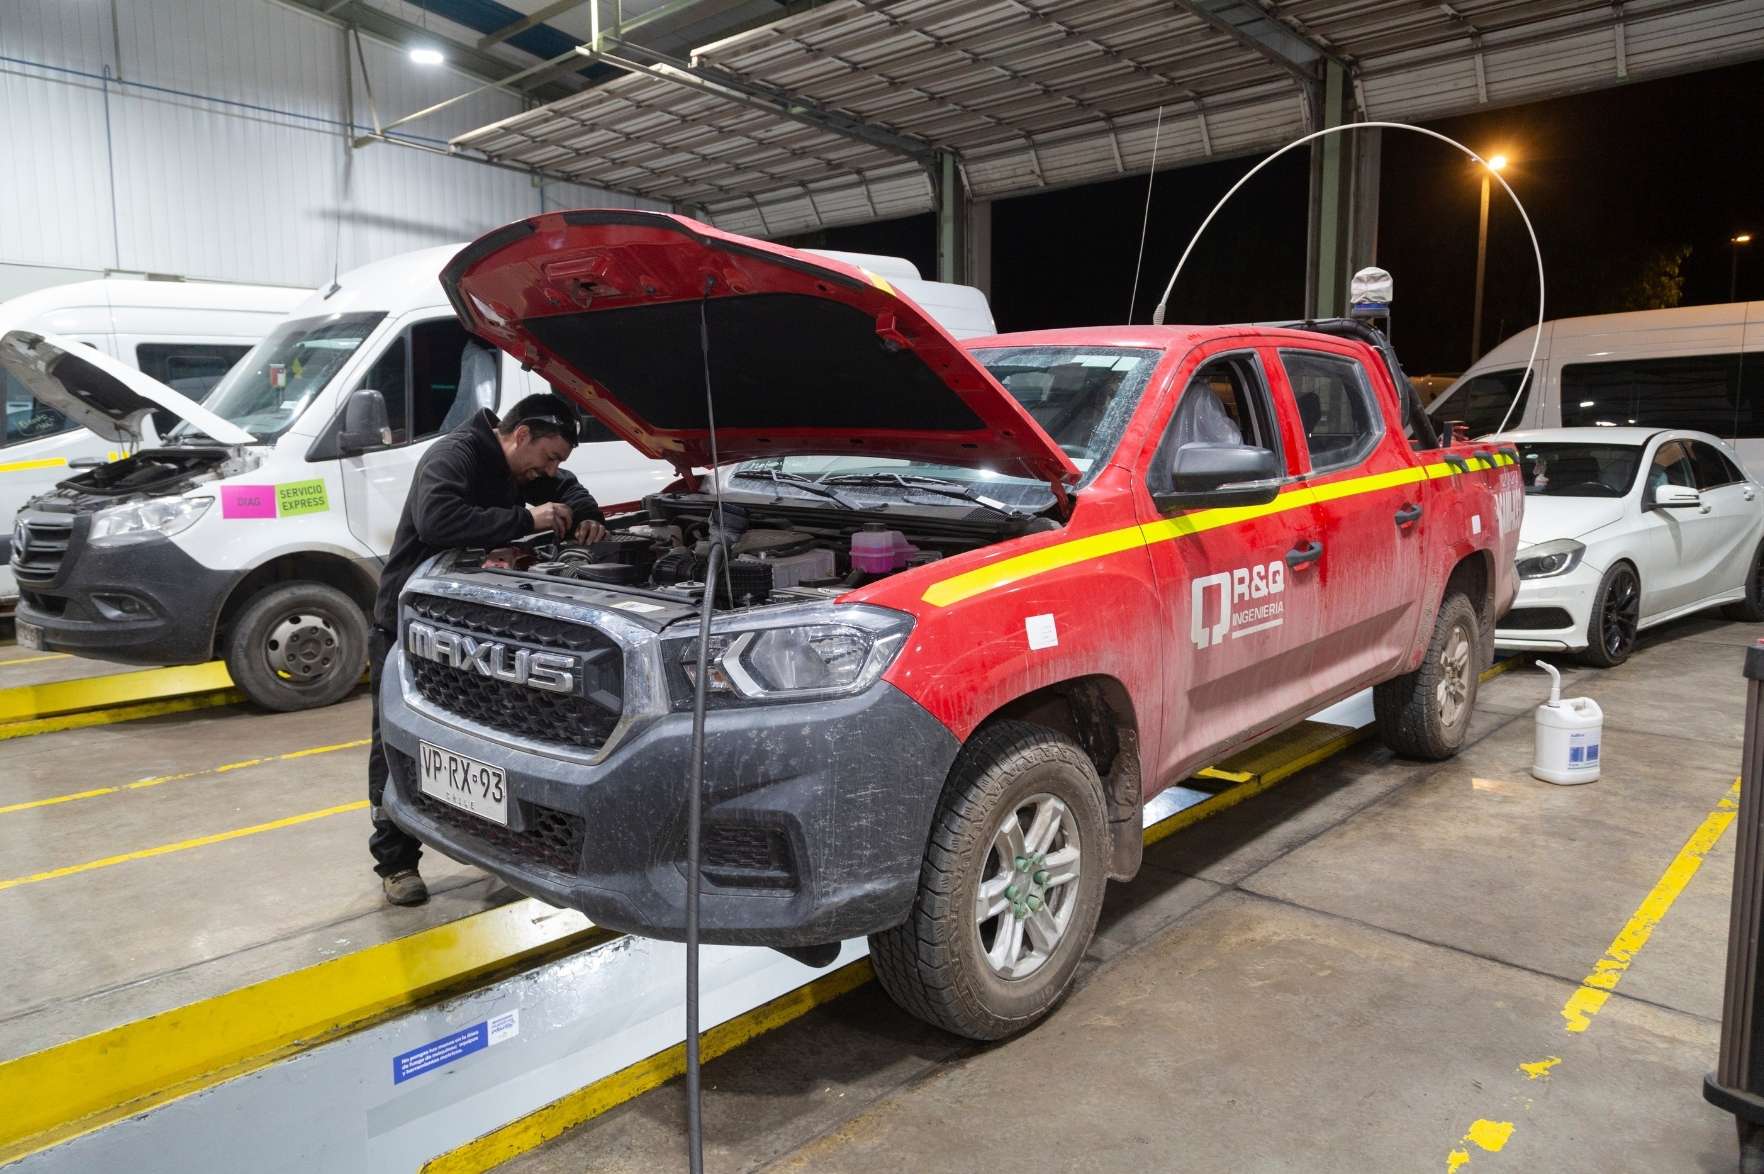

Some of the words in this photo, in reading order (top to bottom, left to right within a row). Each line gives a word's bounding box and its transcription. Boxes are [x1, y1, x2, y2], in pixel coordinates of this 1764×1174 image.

[280, 484, 322, 499] SERVICIO
[238, 497, 261, 507] DIAG
[282, 496, 325, 511] EXPRESS
[1232, 560, 1285, 604] R&Q
[1232, 600, 1284, 626] INGENIERIA
[408, 620, 575, 693] MAXUS
